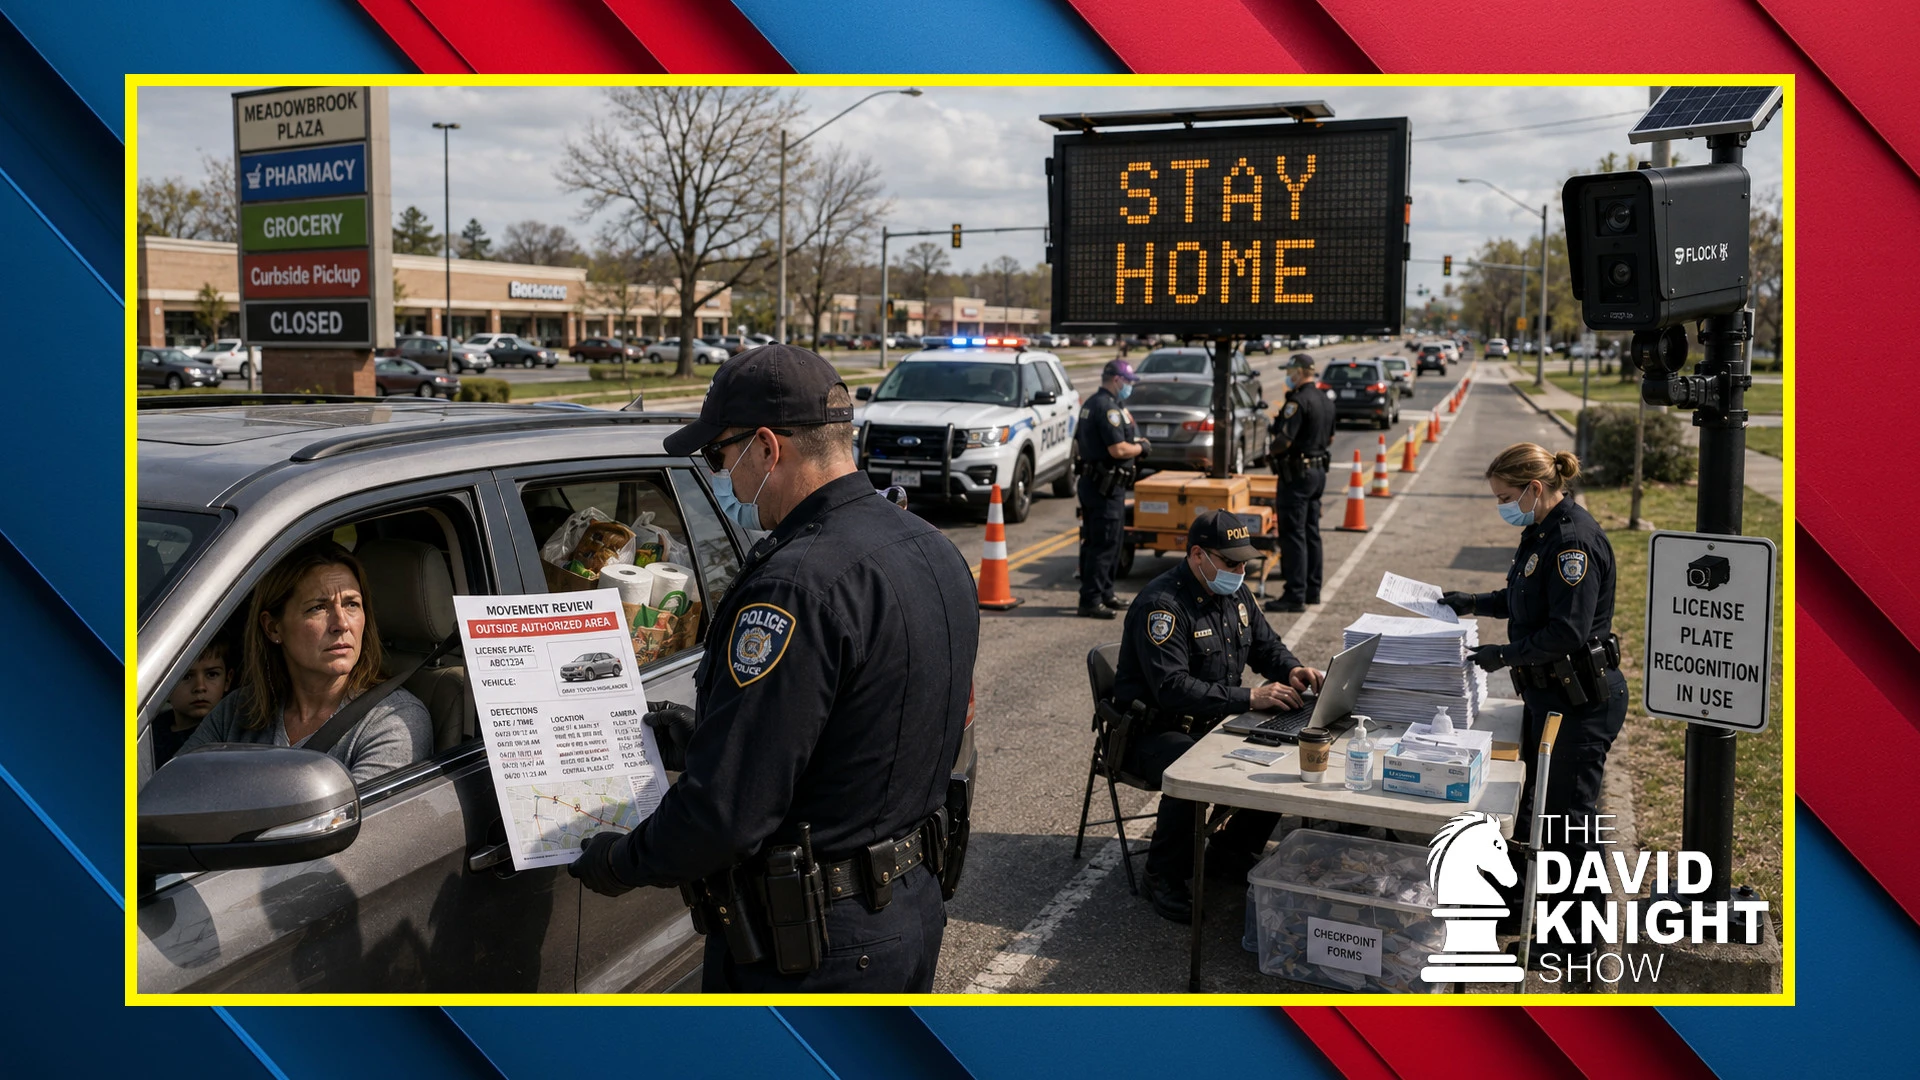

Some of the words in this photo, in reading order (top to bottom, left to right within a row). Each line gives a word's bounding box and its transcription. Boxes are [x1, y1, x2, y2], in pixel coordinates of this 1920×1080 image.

[244, 92, 358, 124] MEADOWBROOK
[278, 119, 324, 140] PLAZA
[265, 158, 356, 188] PHARMACY
[1119, 154, 1317, 226] STAY
[263, 212, 344, 238] GROCERY
[1686, 244, 1718, 262] FLOCK
[251, 266, 309, 287] Curbside
[312, 264, 361, 288] Pickup
[1115, 238, 1316, 305] HOME
[270, 310, 343, 335] CLOSED
[1041, 421, 1066, 452] POLICE
[486, 604, 550, 616] MOVEMENT
[552, 600, 593, 612] REVIEW
[1673, 596, 1744, 622] LICENSE
[476, 621, 518, 634] OUTSIDE
[521, 620, 582, 632] AUTHORIZED
[585, 617, 611, 628] AREA
[739, 610, 788, 634] POLICE
[475, 646, 508, 654] LICENSE
[508, 645, 535, 654] PLATE:
[1680, 626, 1734, 650] PLATE
[490, 658, 524, 667] ABC1234
[733, 662, 762, 675] POLICE
[1654, 652, 1759, 683] RECOGNITION
[482, 678, 516, 687] VEHICLE:
[1677, 684, 1693, 702] IN
[1700, 688, 1734, 709] USE
[490, 706, 538, 716] DETECTIONS
[550, 714, 584, 723] LOCATION
[1314, 928, 1376, 948] CHECKPOINT
[1328, 946, 1362, 961] FORMS
